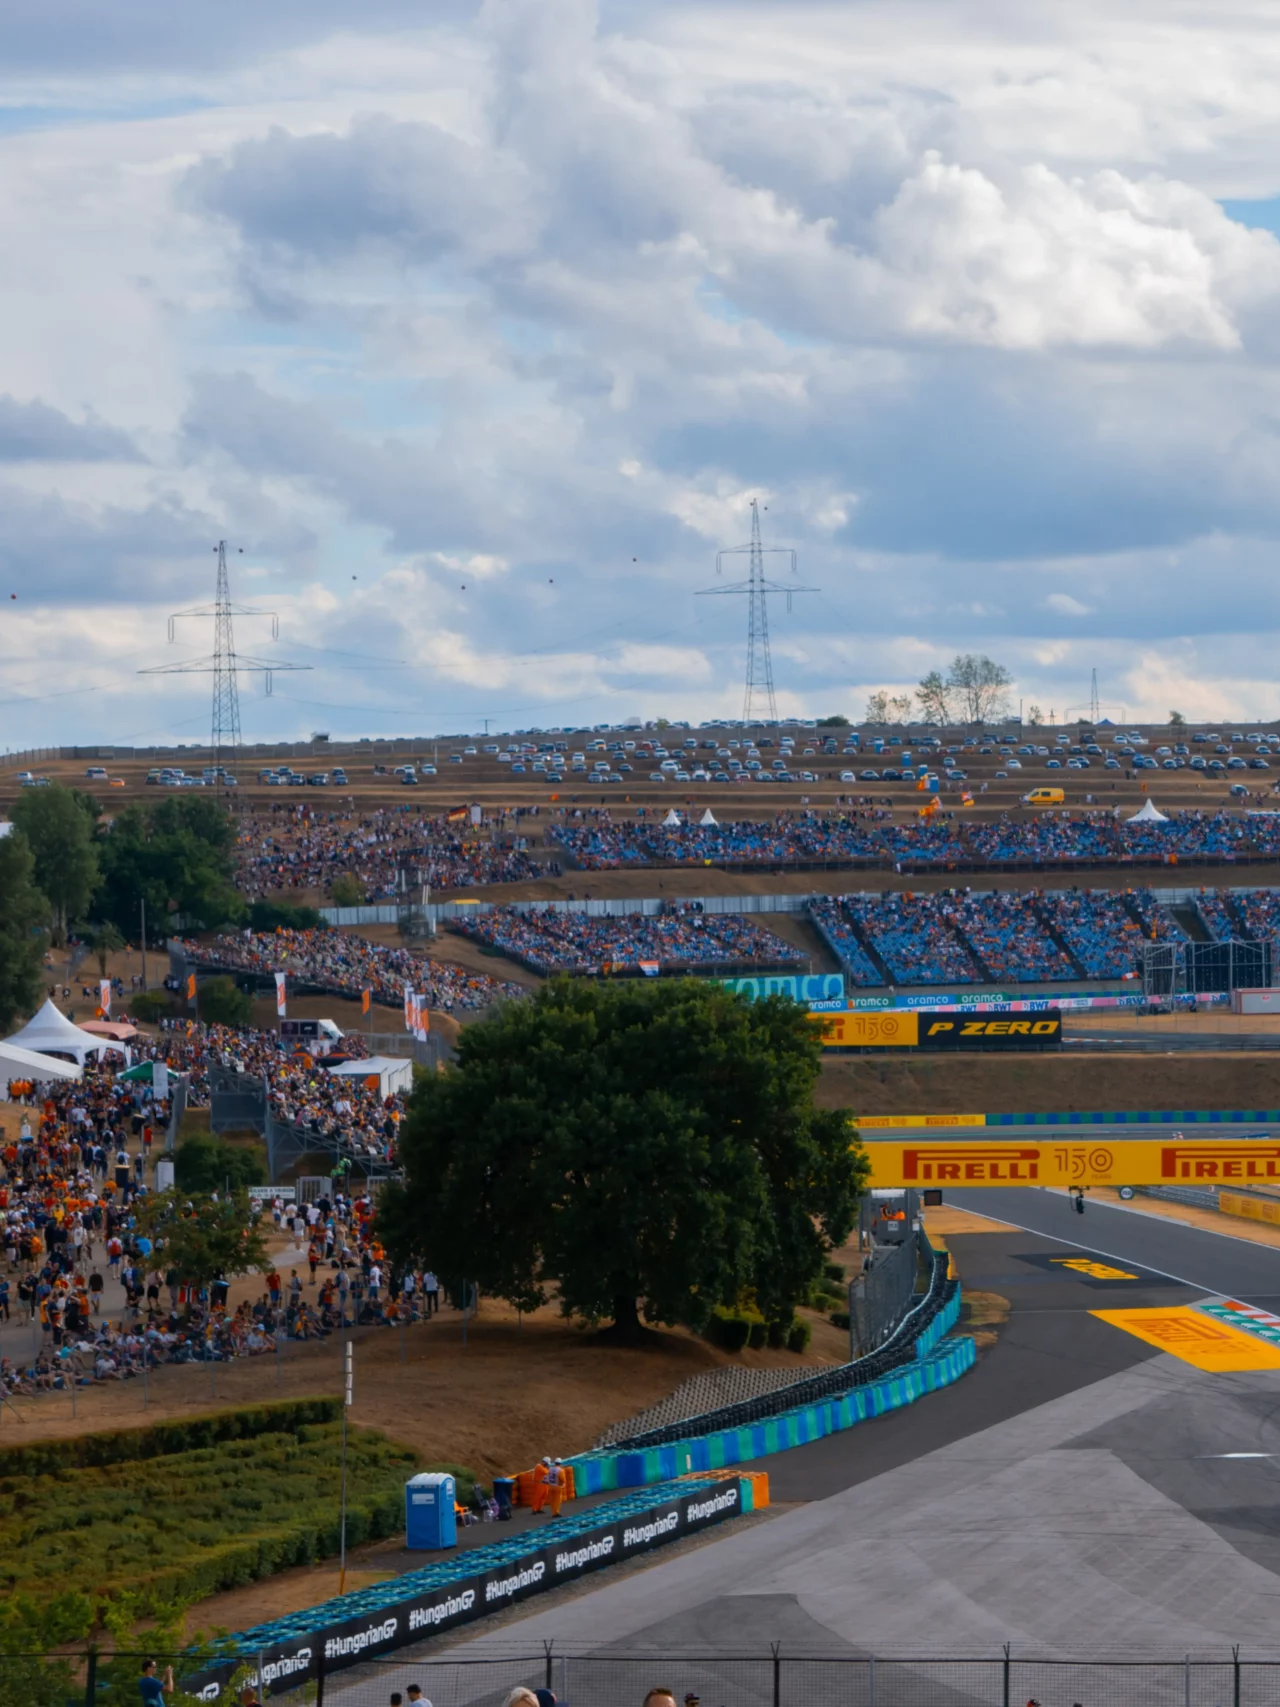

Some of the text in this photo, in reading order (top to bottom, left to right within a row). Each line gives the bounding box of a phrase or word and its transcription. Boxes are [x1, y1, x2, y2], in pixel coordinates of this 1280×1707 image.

[808, 1000, 841, 1010] aramco
[852, 997, 889, 1008] aramco
[908, 996, 949, 1005] aramco
[962, 993, 1003, 1003] aramco
[1030, 1001, 1049, 1011] BWT
[961, 1004, 977, 1012] BWT
[993, 1002, 1011, 1012] BWT
[927, 1020, 1059, 1036] P ZERO
[903, 1148, 1113, 1179] PIRELLI 150
[687, 1488, 737, 1522] #HungarianGP
[623, 1511, 679, 1547] #HungarianGP
[555, 1535, 614, 1573] #HungarianGP
[486, 1561, 545, 1601] #HungarianGP
[409, 1589, 475, 1631] #HungarianGP
[324, 1617, 397, 1658] #HungarianGP
